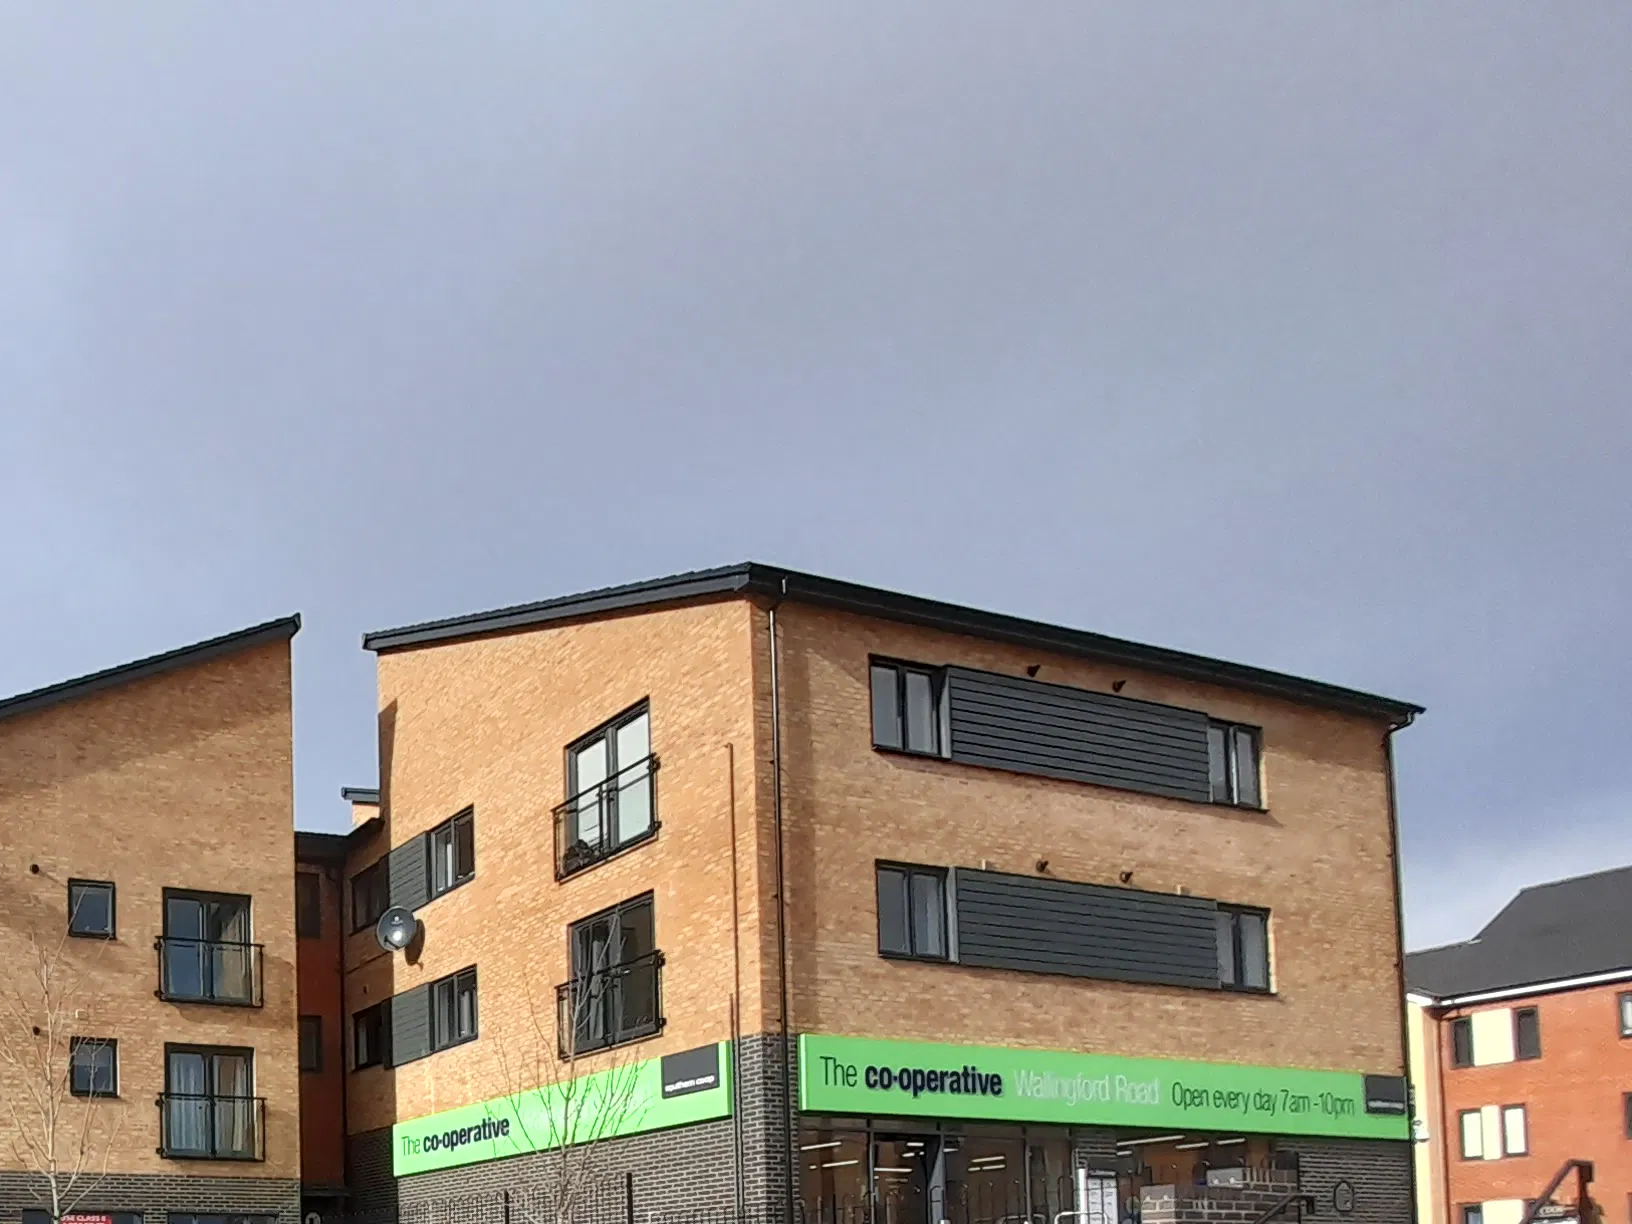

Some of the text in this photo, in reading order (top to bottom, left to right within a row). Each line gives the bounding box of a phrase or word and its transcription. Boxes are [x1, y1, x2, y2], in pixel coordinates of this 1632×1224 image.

[820, 1056, 858, 1087] The
[864, 1064, 1003, 1099] co-operative
[1116, 1074, 1160, 1105] Road
[1172, 1081, 1209, 1110] Open
[1213, 1088, 1250, 1115] every
[1253, 1087, 1277, 1117] day
[401, 1116, 510, 1156] The co-operative
